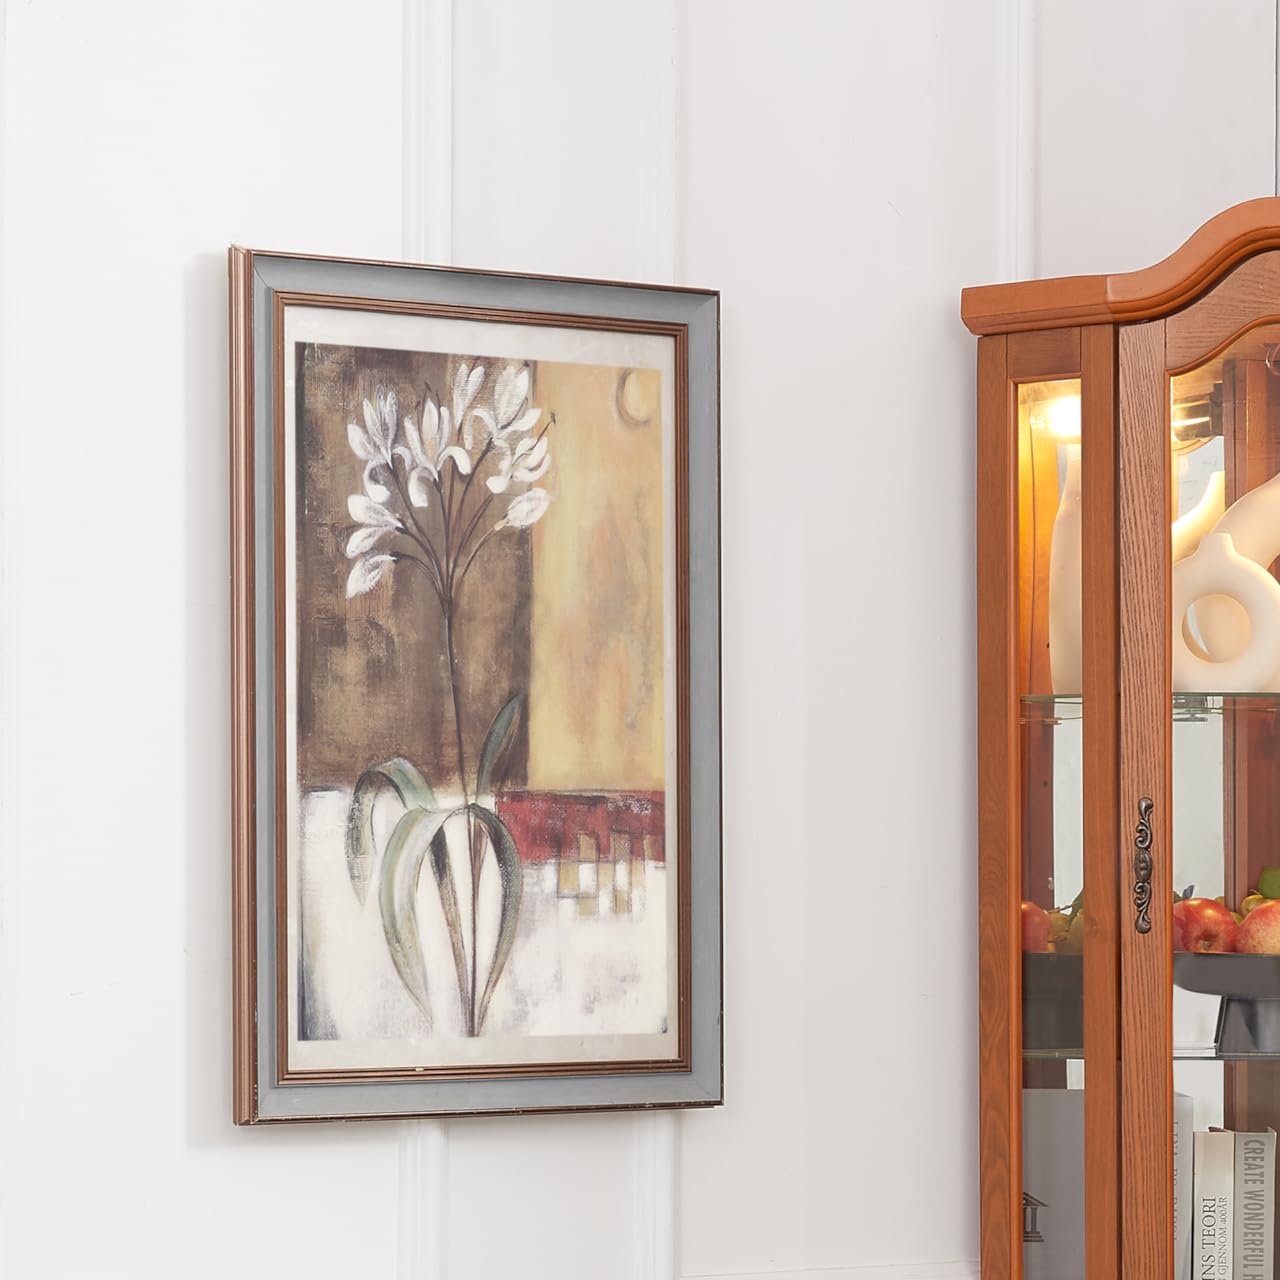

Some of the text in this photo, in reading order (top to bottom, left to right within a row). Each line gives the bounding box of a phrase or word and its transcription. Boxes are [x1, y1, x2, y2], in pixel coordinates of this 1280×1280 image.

[1243, 1139, 1265, 1185] CREATE
[1202, 1197, 1217, 1250] TEORI
[1243, 1189, 1265, 1269] WONDERFUL
[1218, 1227, 1229, 1276] GJENNOM
